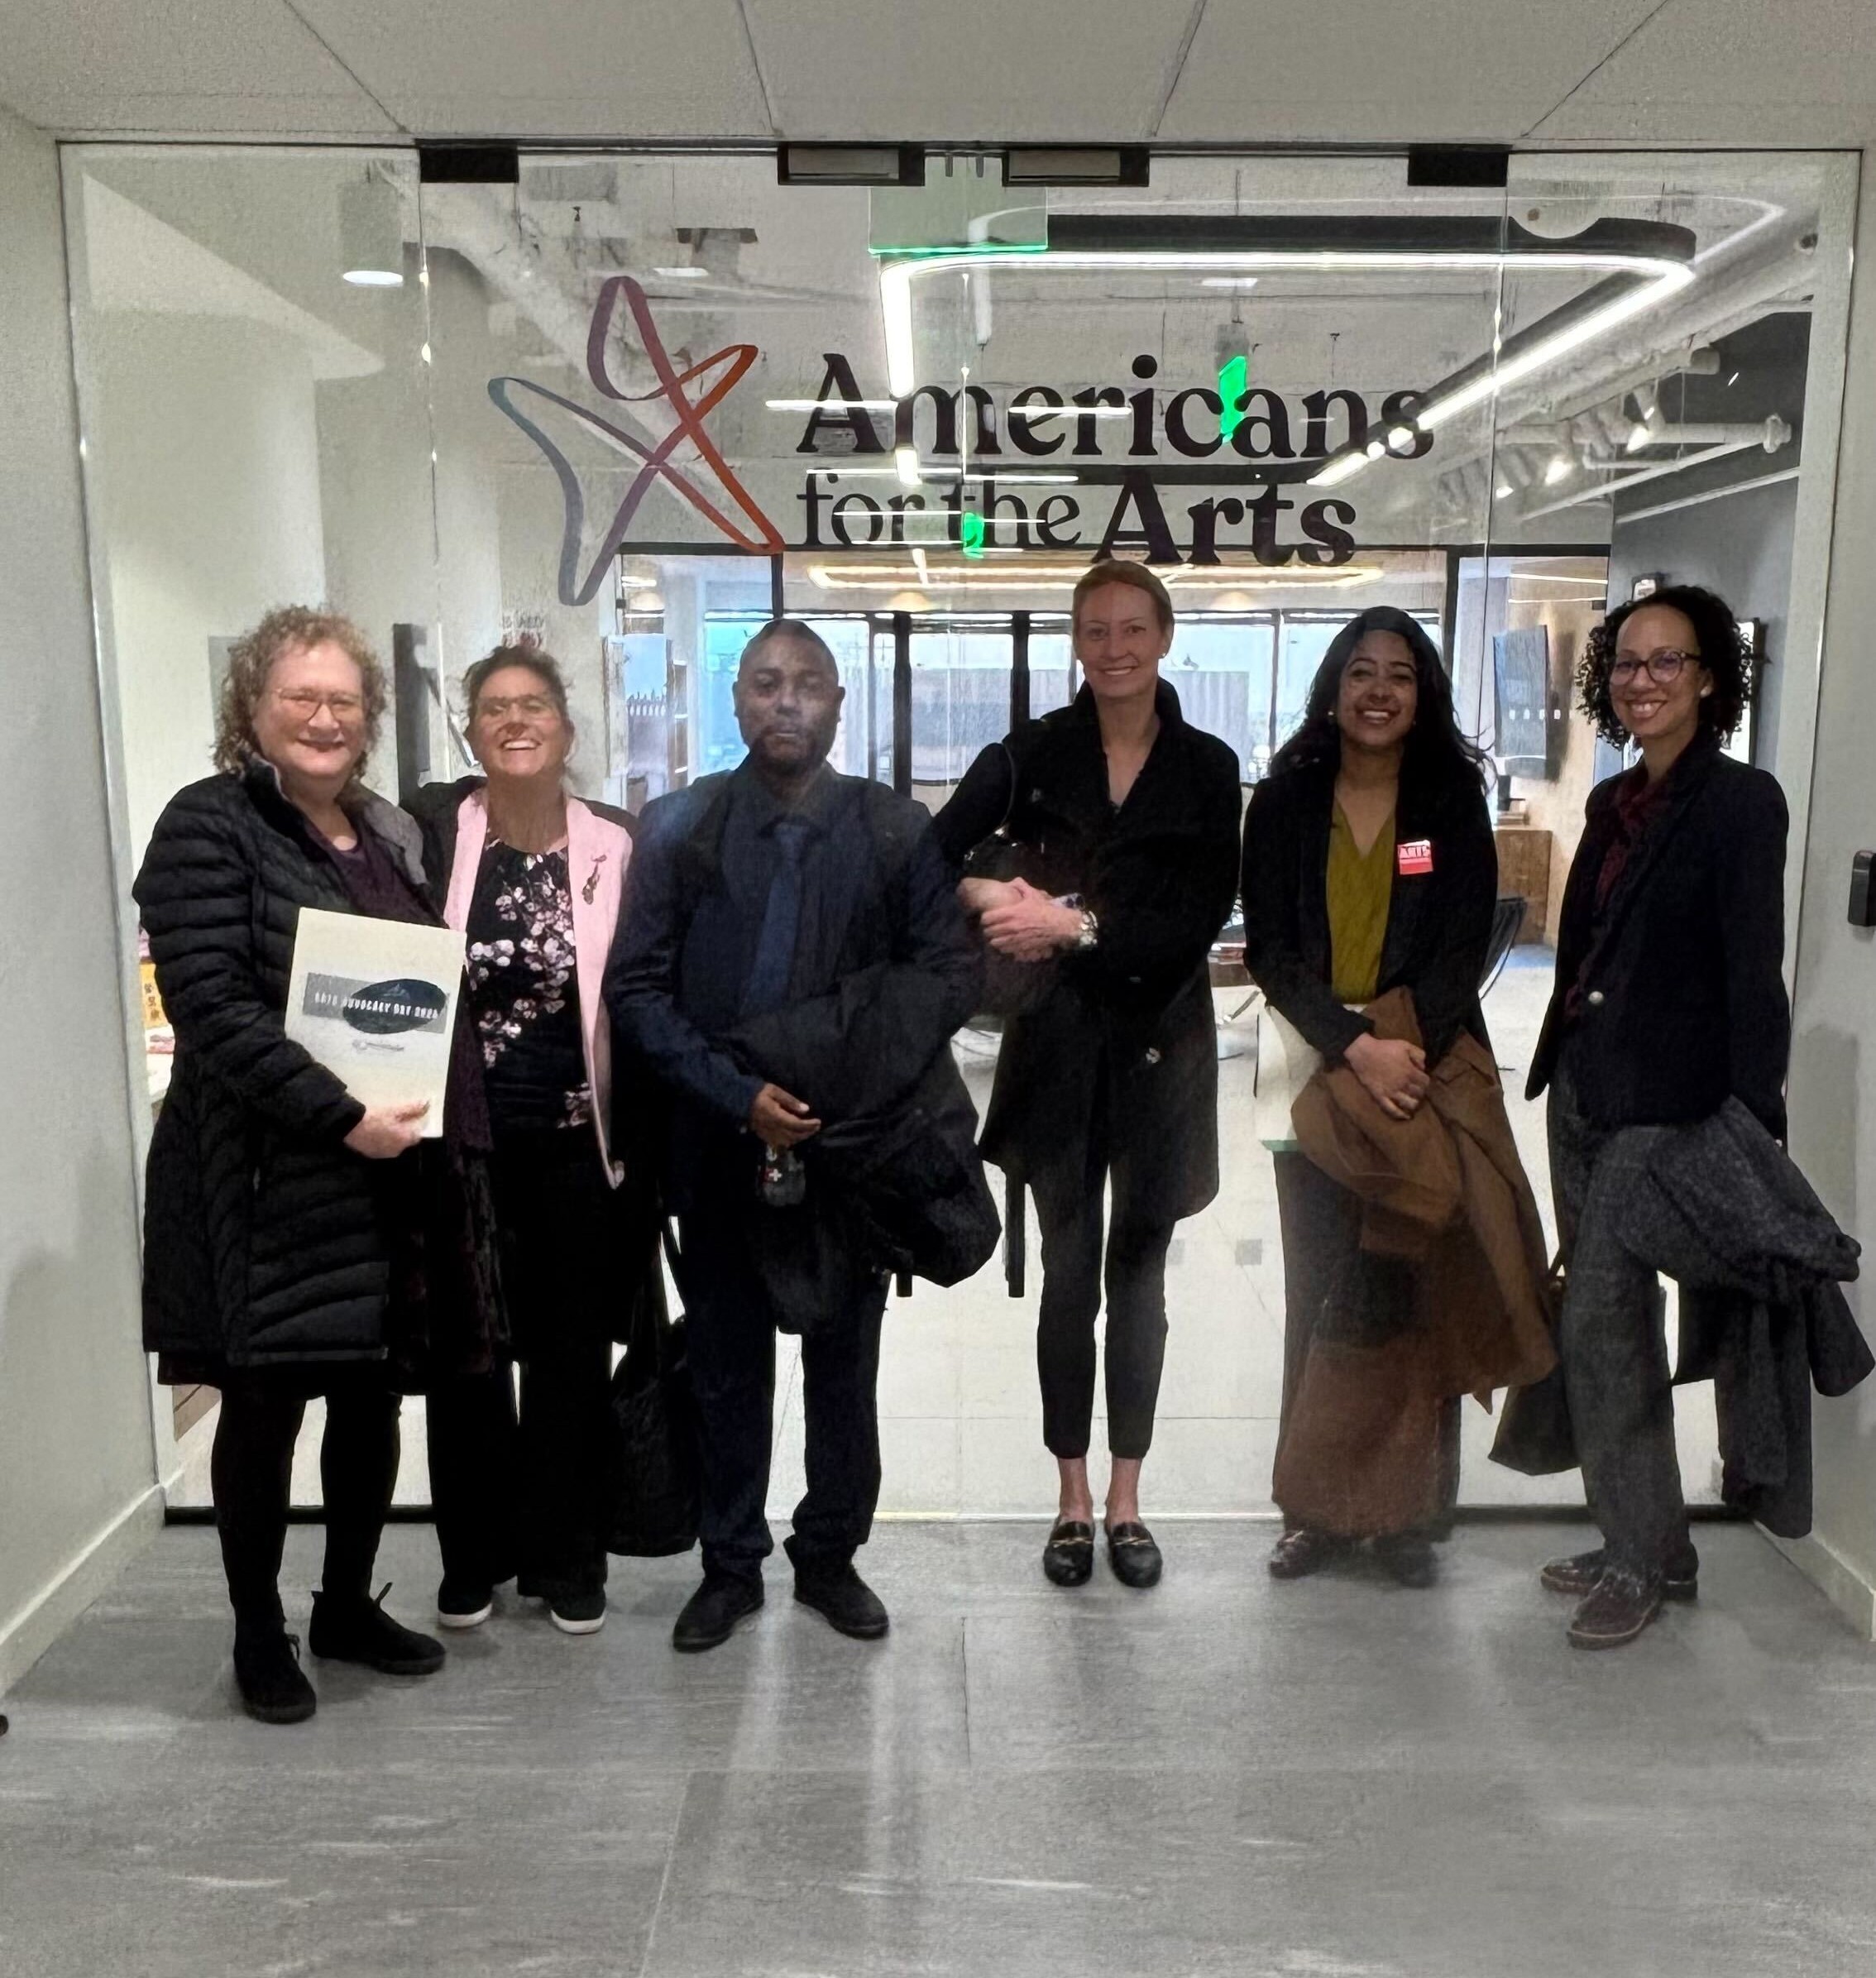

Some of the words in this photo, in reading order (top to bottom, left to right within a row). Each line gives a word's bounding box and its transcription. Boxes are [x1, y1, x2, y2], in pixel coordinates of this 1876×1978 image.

[797, 353, 1435, 460] Americans
[797, 468, 925, 546] for
[940, 469, 1081, 547] the
[1092, 467, 1357, 566] Arts
